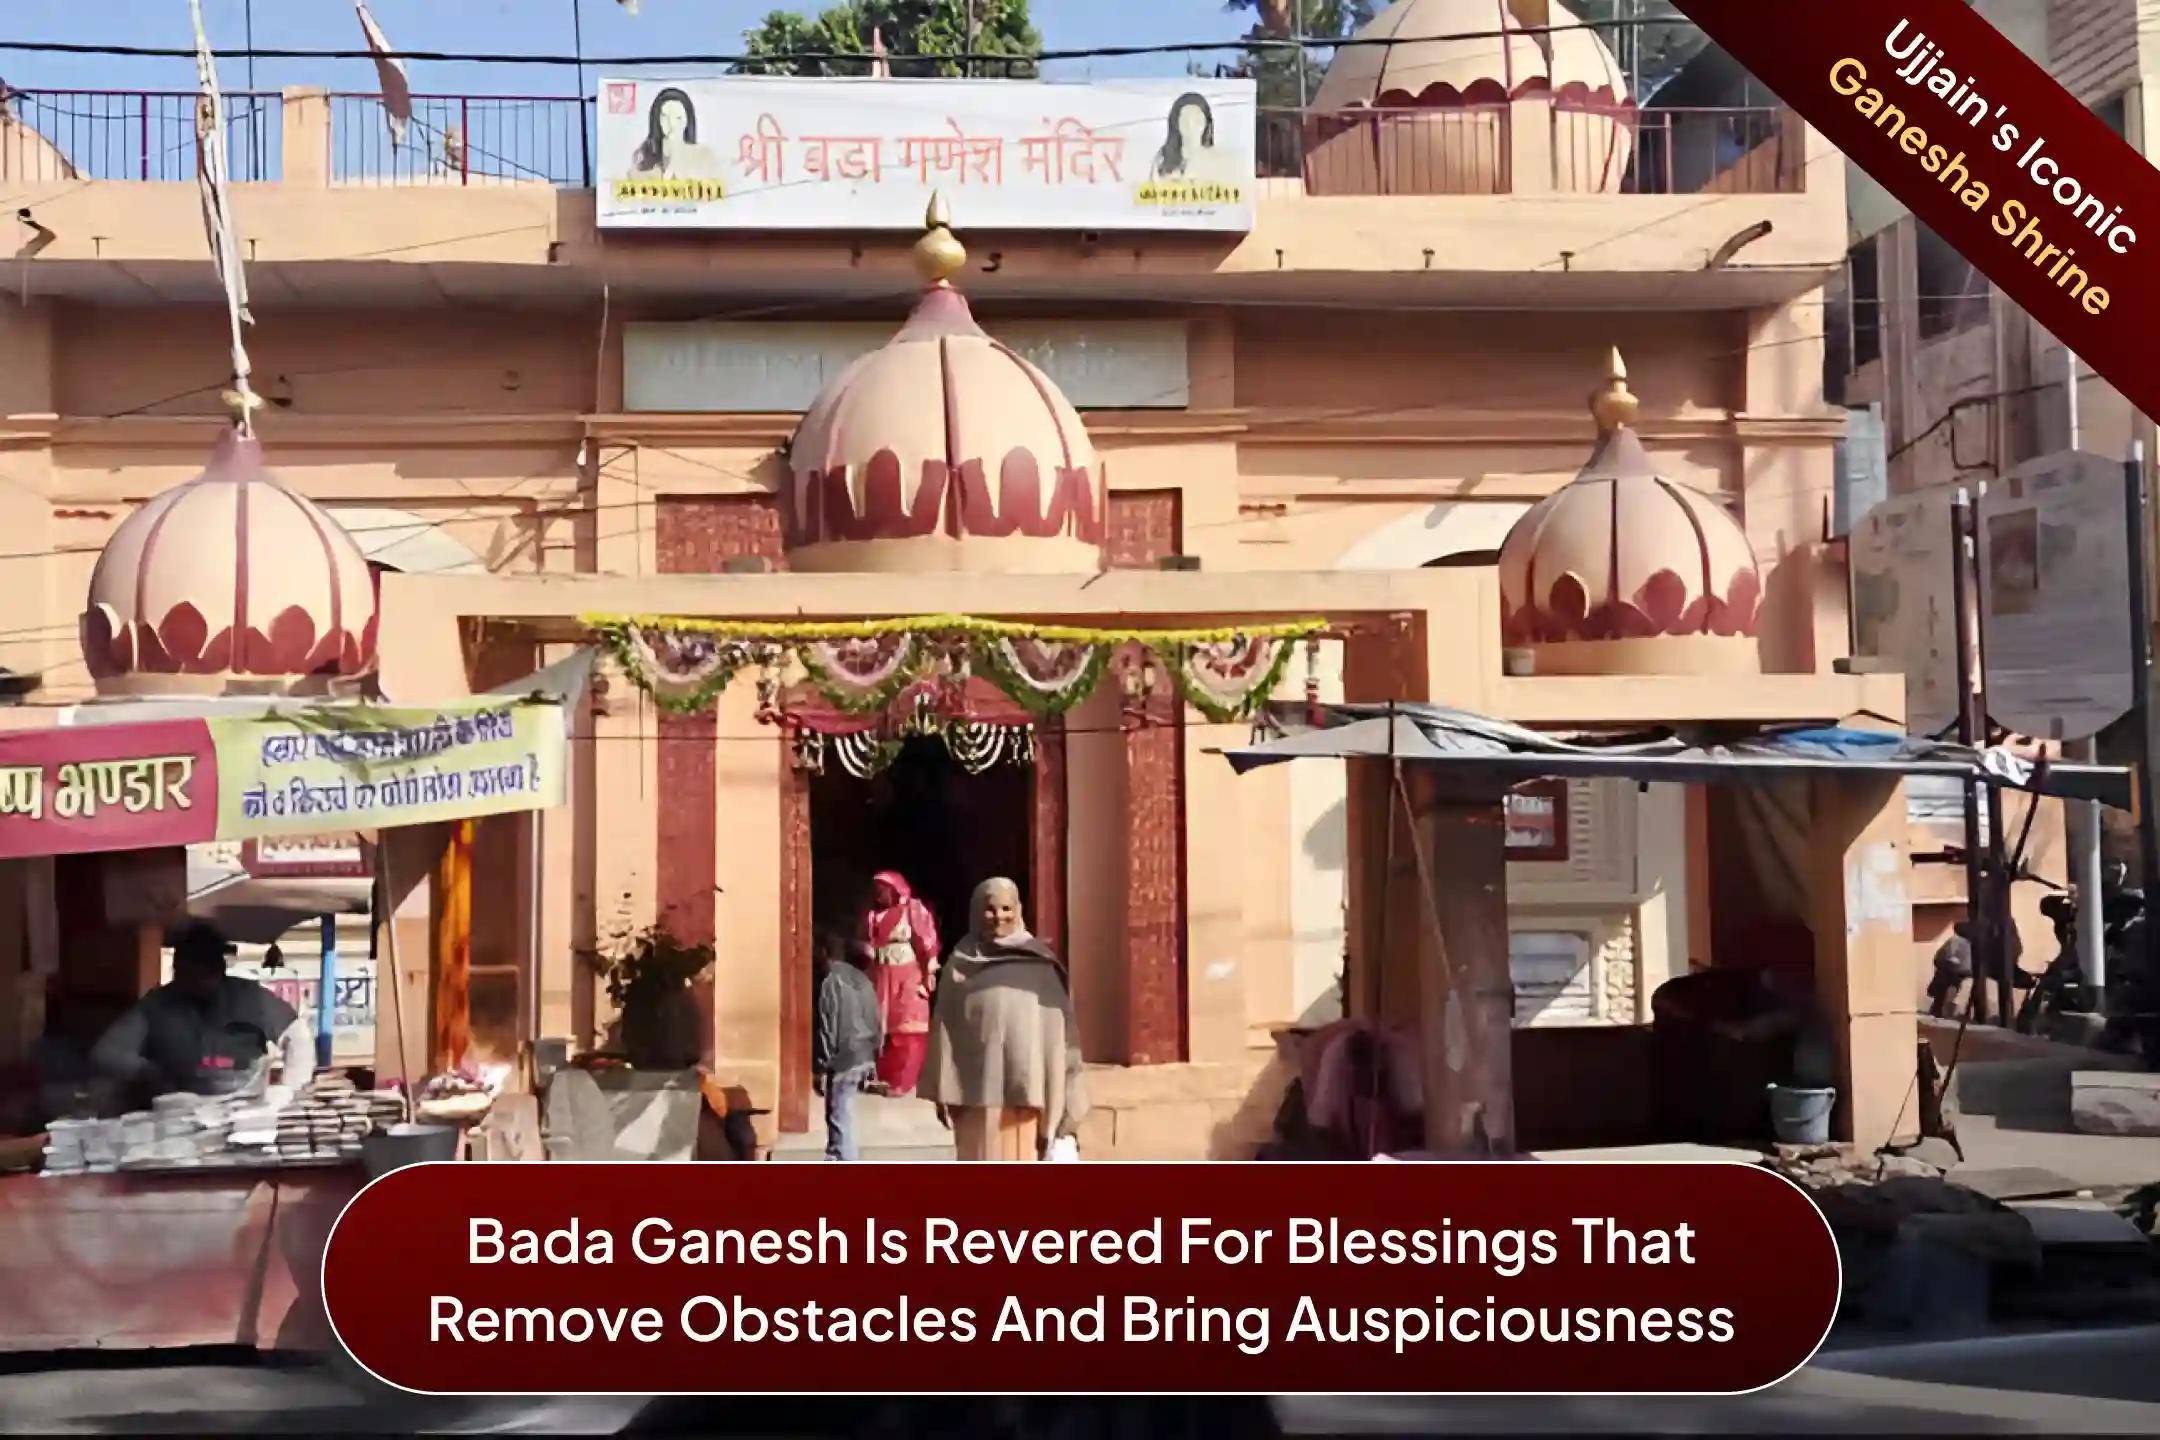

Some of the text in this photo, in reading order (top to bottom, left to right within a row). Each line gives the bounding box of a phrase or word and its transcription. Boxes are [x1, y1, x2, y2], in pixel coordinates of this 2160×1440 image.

[731, 112, 789, 184] श्री
[896, 115, 1004, 185] गणेश
[1018, 115, 1127, 185] मंदिर
[54, 756, 197, 819] भण्डार
